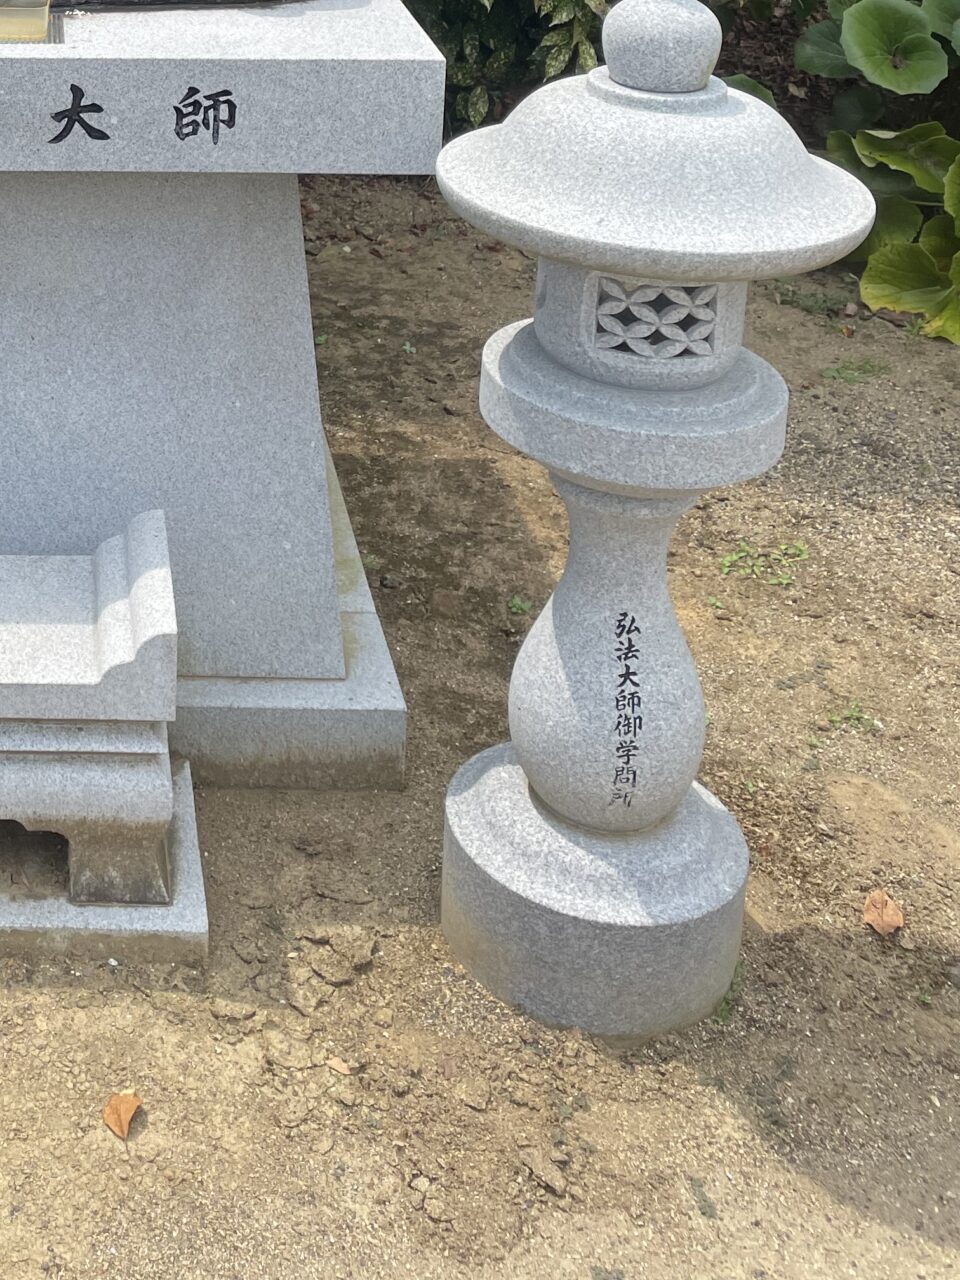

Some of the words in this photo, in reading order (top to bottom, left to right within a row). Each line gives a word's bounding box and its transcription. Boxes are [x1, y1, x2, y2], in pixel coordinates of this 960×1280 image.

[609, 612, 643, 807] 弘法大師御学問所
